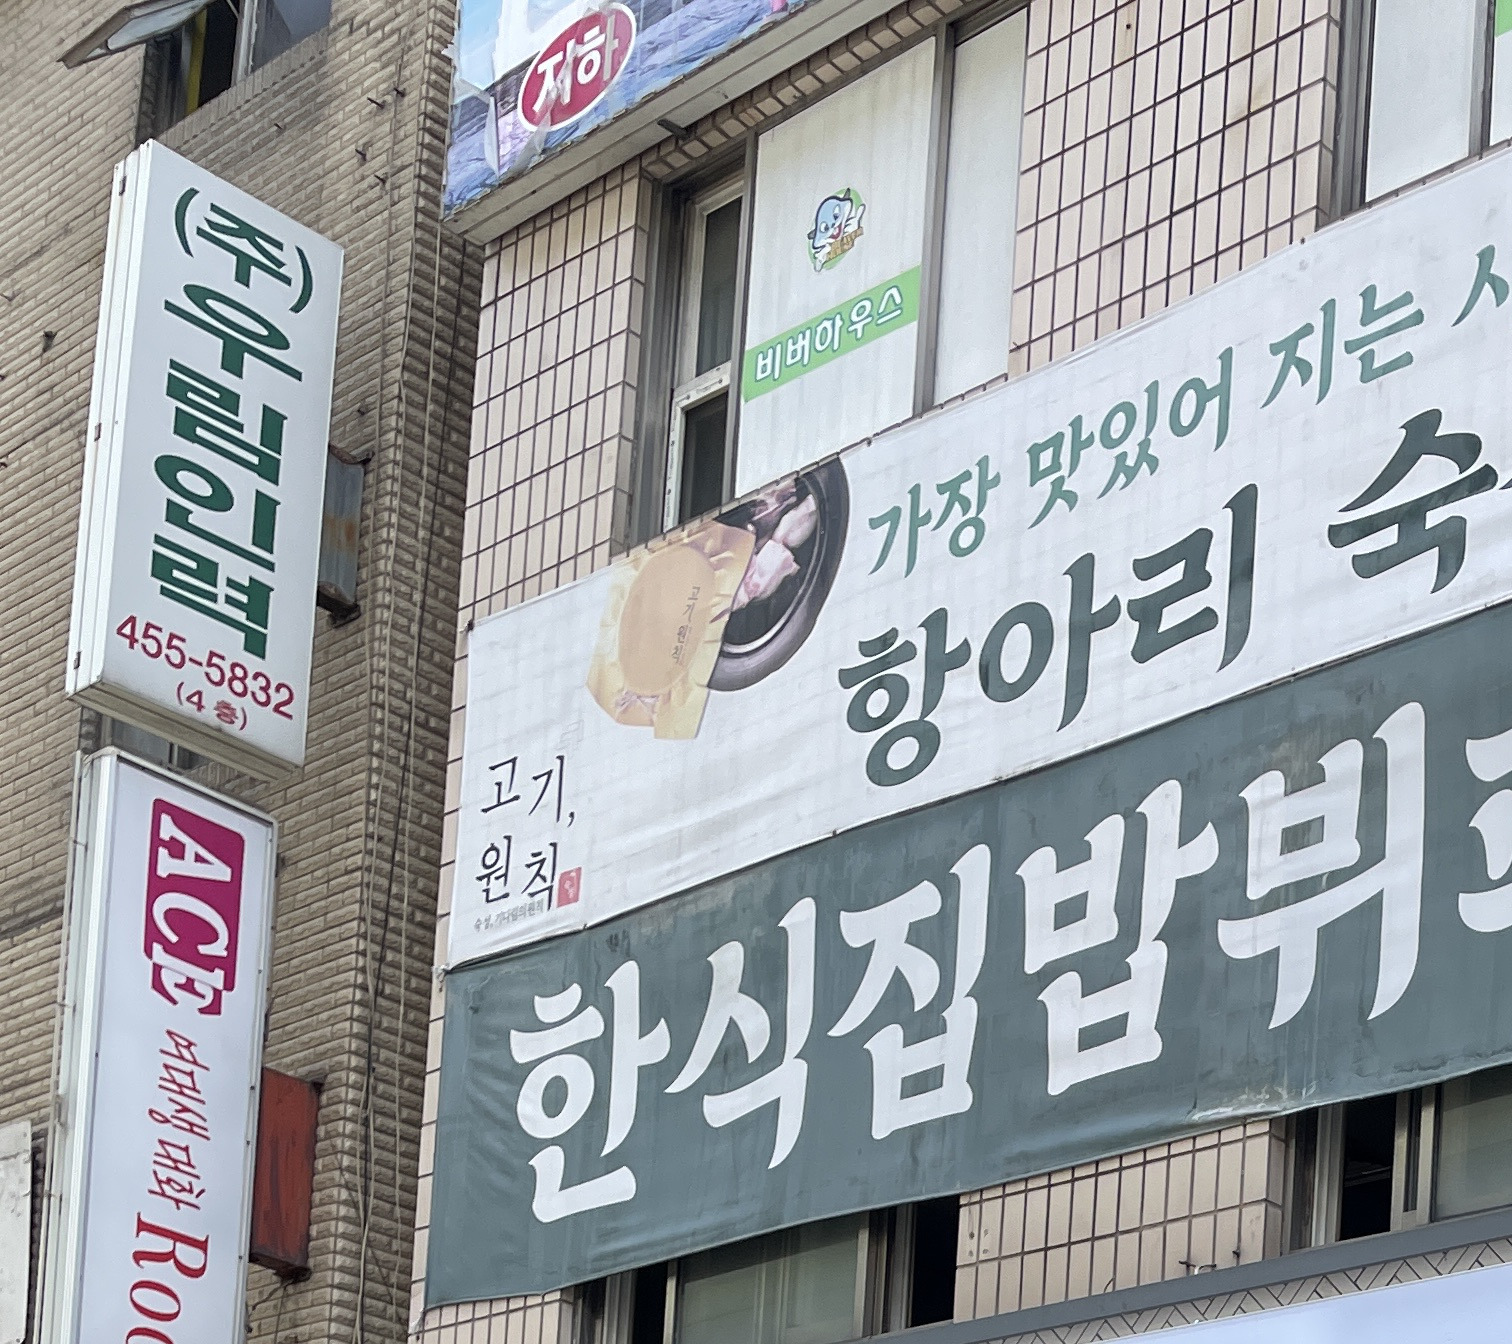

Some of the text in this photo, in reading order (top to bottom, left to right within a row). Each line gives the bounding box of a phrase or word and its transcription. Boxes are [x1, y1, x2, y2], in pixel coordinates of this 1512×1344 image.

[531, 14, 619, 113] 지하
[755, 283, 906, 384] 비버하우스
[870, 455, 1001, 579] 가장
[1026, 347, 1234, 529] 맛있어
[1260, 285, 1425, 410] 지는
[116, 615, 296, 721] 455-5832
[838, 483, 1260, 788] 항아리
[481, 755, 575, 827] 고기,
[150, 812, 235, 1014] ACE
[475, 834, 558, 911] 원칙
